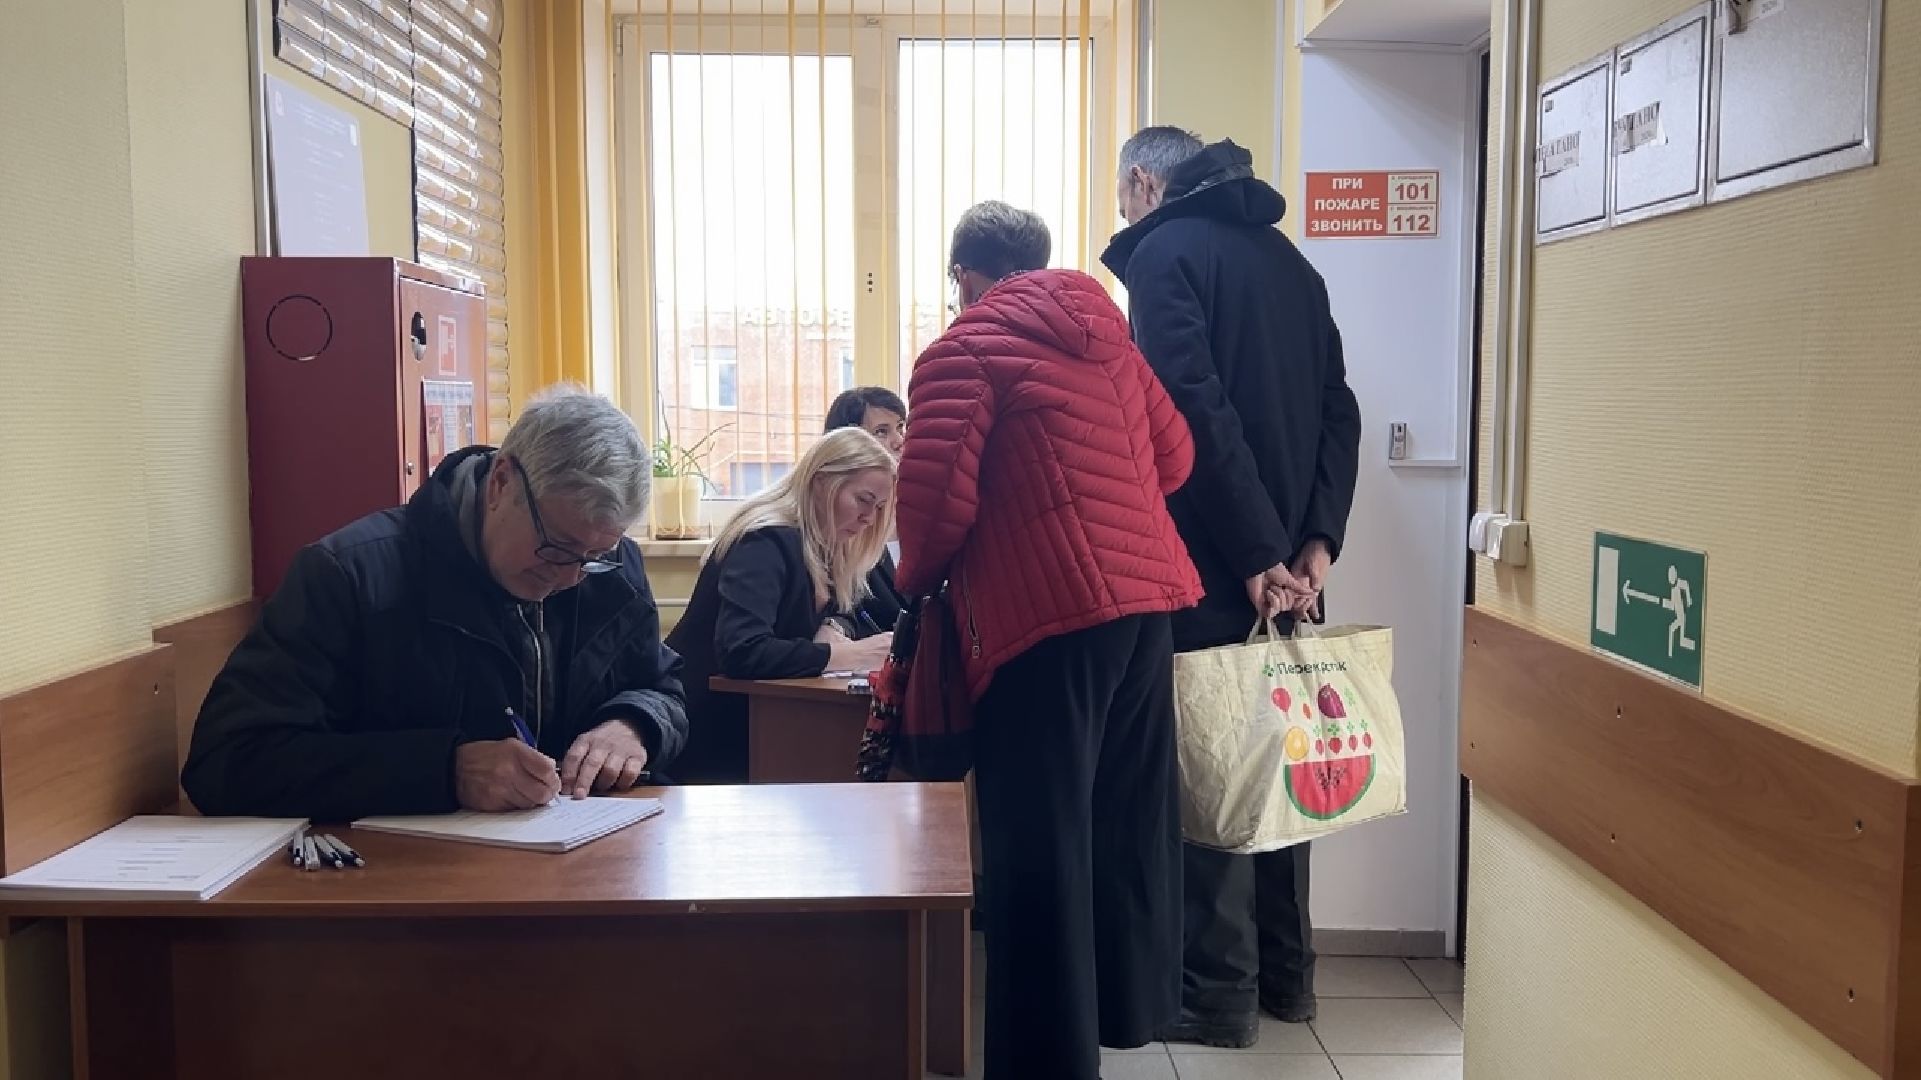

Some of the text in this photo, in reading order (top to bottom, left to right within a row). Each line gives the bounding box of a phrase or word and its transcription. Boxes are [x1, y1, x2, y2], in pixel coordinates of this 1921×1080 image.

[1332, 178, 1363, 190] ПРИ
[1395, 182, 1429, 200] 101
[1315, 198, 1380, 211] ПОЖАРЕ
[1311, 218, 1383, 232] ЗВОНИТЬ
[1393, 214, 1430, 231] 112
